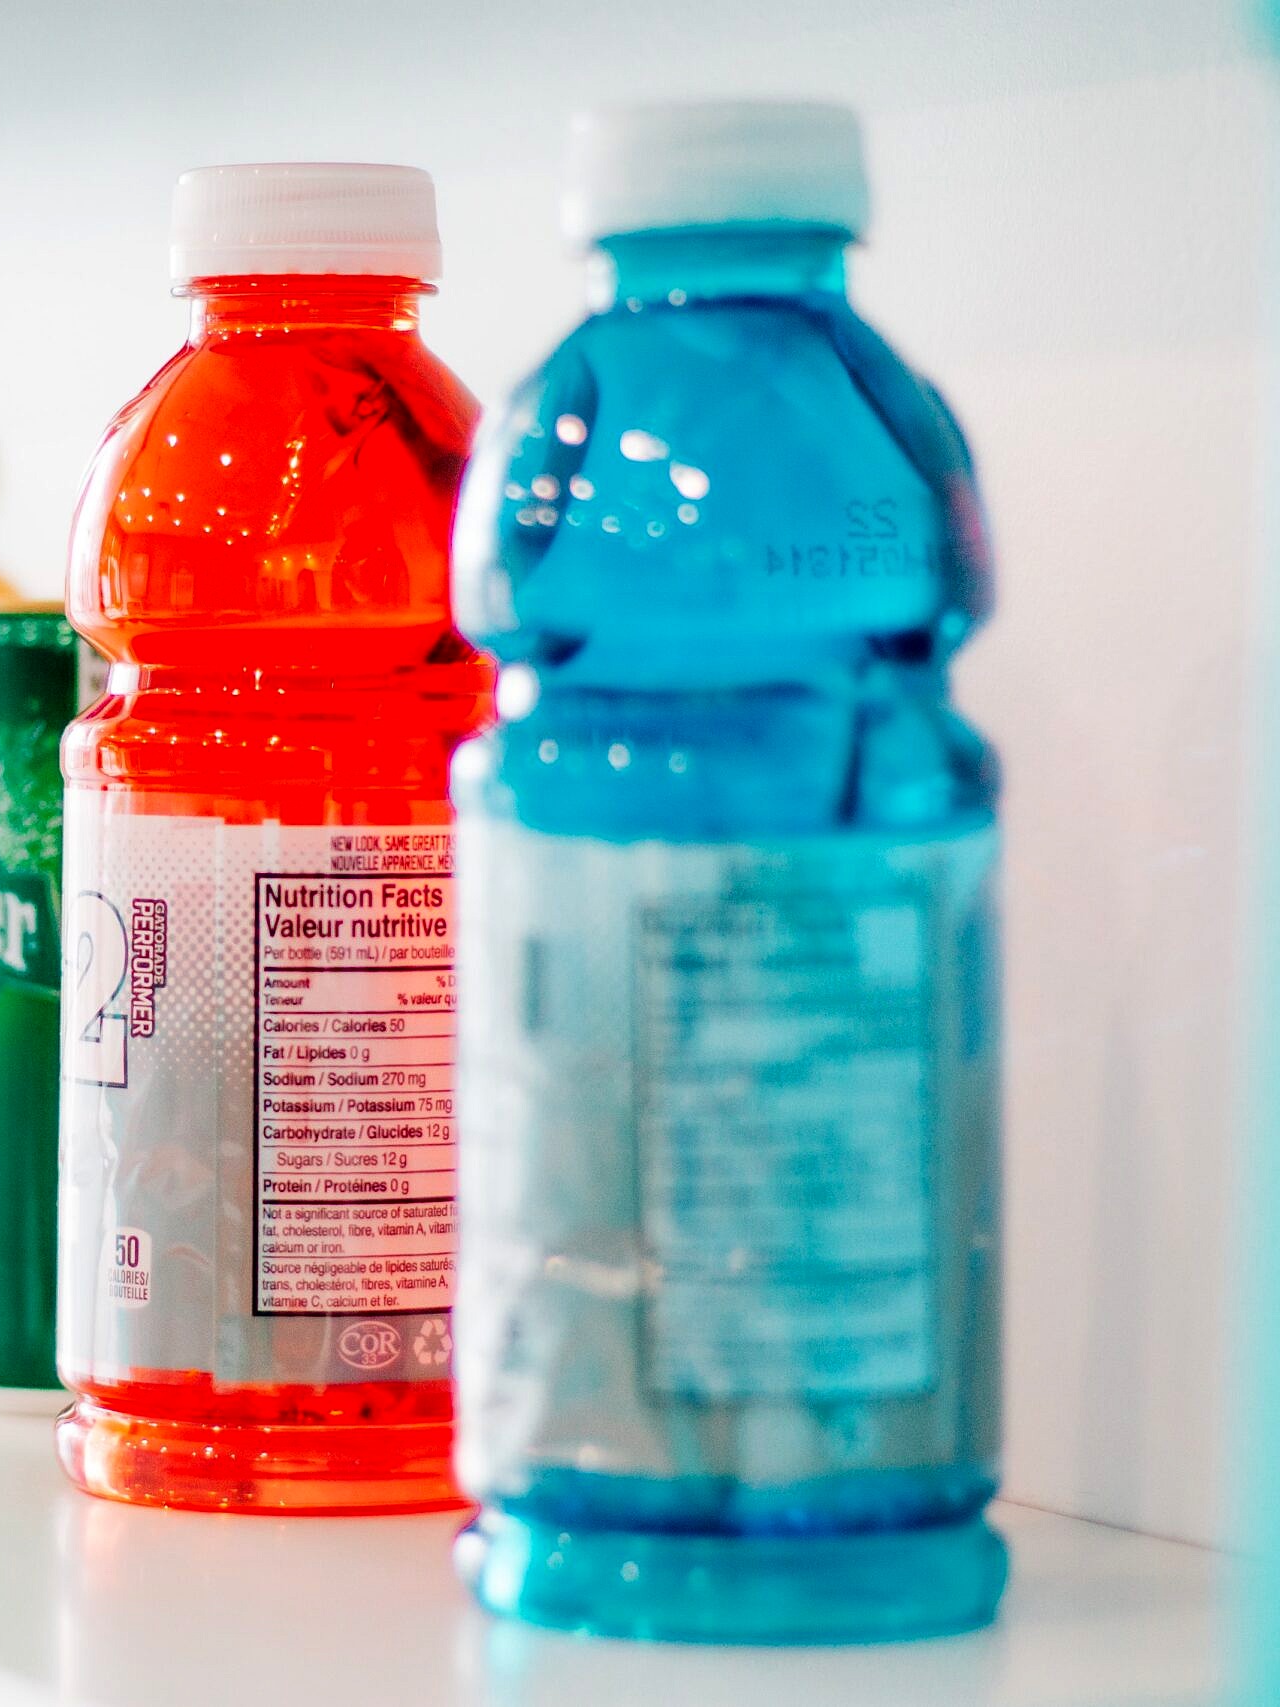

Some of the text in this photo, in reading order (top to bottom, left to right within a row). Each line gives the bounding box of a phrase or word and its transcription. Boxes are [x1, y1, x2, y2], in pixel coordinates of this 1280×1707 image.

[331, 836, 353, 851] NEW
[385, 836, 410, 851] SAME
[412, 836, 440, 851] GREAT
[331, 855, 379, 871] NOUVELLE
[265, 883, 444, 909] Nutrition Facts
[265, 913, 447, 938] Valeur nutritive
[153, 902, 166, 985] GATORADE
[264, 946, 285, 960] Per
[288, 946, 321, 960] bottle
[325, 945, 352, 962] (591
[356, 945, 380, 962] mL)
[389, 948, 409, 962] par
[411, 944, 456, 960] bouteille
[131, 901, 155, 1036] PERFORMER
[264, 977, 311, 989] Amount
[264, 994, 304, 1006] Teneur
[410, 992, 442, 1005] valeur
[264, 1018, 320, 1033] Calories
[331, 1018, 387, 1033] Calories
[389, 1018, 406, 1033] 50
[264, 1045, 285, 1060] Fat
[296, 1045, 347, 1062] Lipides
[350, 1045, 358, 1060] 0
[361, 1048, 371, 1063] g
[263, 1072, 316, 1086] Sodium
[327, 1071, 379, 1086] Sodium
[382, 1072, 405, 1086] 270
[407, 1073, 426, 1088] mg
[263, 1099, 336, 1113] Potassium
[347, 1098, 416, 1113] Potassium
[418, 1097, 433, 1111] 75
[435, 1099, 453, 1114] mg
[263, 1125, 356, 1142] Carbohydrate
[366, 1124, 424, 1139] Glucides
[426, 1123, 441, 1138] 12
[442, 1125, 451, 1140] g
[277, 1152, 323, 1169] Sugars
[334, 1152, 379, 1166] Sucres
[382, 1152, 396, 1166] 12
[399, 1154, 408, 1169] g
[263, 1179, 313, 1193] Protein
[324, 1178, 388, 1193] Protéines
[390, 1178, 398, 1192] 0
[401, 1180, 410, 1195] g
[263, 1207, 282, 1220] Not
[285, 1209, 292, 1220] a
[294, 1207, 350, 1222] significant
[352, 1209, 388, 1220] source
[390, 1206, 401, 1219] of
[402, 1205, 448, 1219] saturated
[262, 1224, 279, 1238] fat,
[282, 1223, 345, 1238] cholesterol,
[348, 1223, 375, 1238] fibre,
[378, 1222, 415, 1236] vitamin
[415, 1222, 427, 1236] A,
[115, 1234, 140, 1268] 50
[263, 1241, 345, 1254] calcium or iron.
[263, 1261, 301, 1274] Source
[304, 1260, 366, 1276] négligeable
[369, 1260, 383, 1273] de
[385, 1259, 418, 1274] lipides
[262, 1279, 293, 1292] trans,
[361, 1277, 393, 1291] fibres,
[396, 1276, 437, 1289] vitamine
[438, 1275, 448, 1289] A,
[262, 1293, 400, 1308] vitamine C, calcium et fer.
[340, 1331, 401, 1356] COR
[361, 1352, 377, 1365] 33
